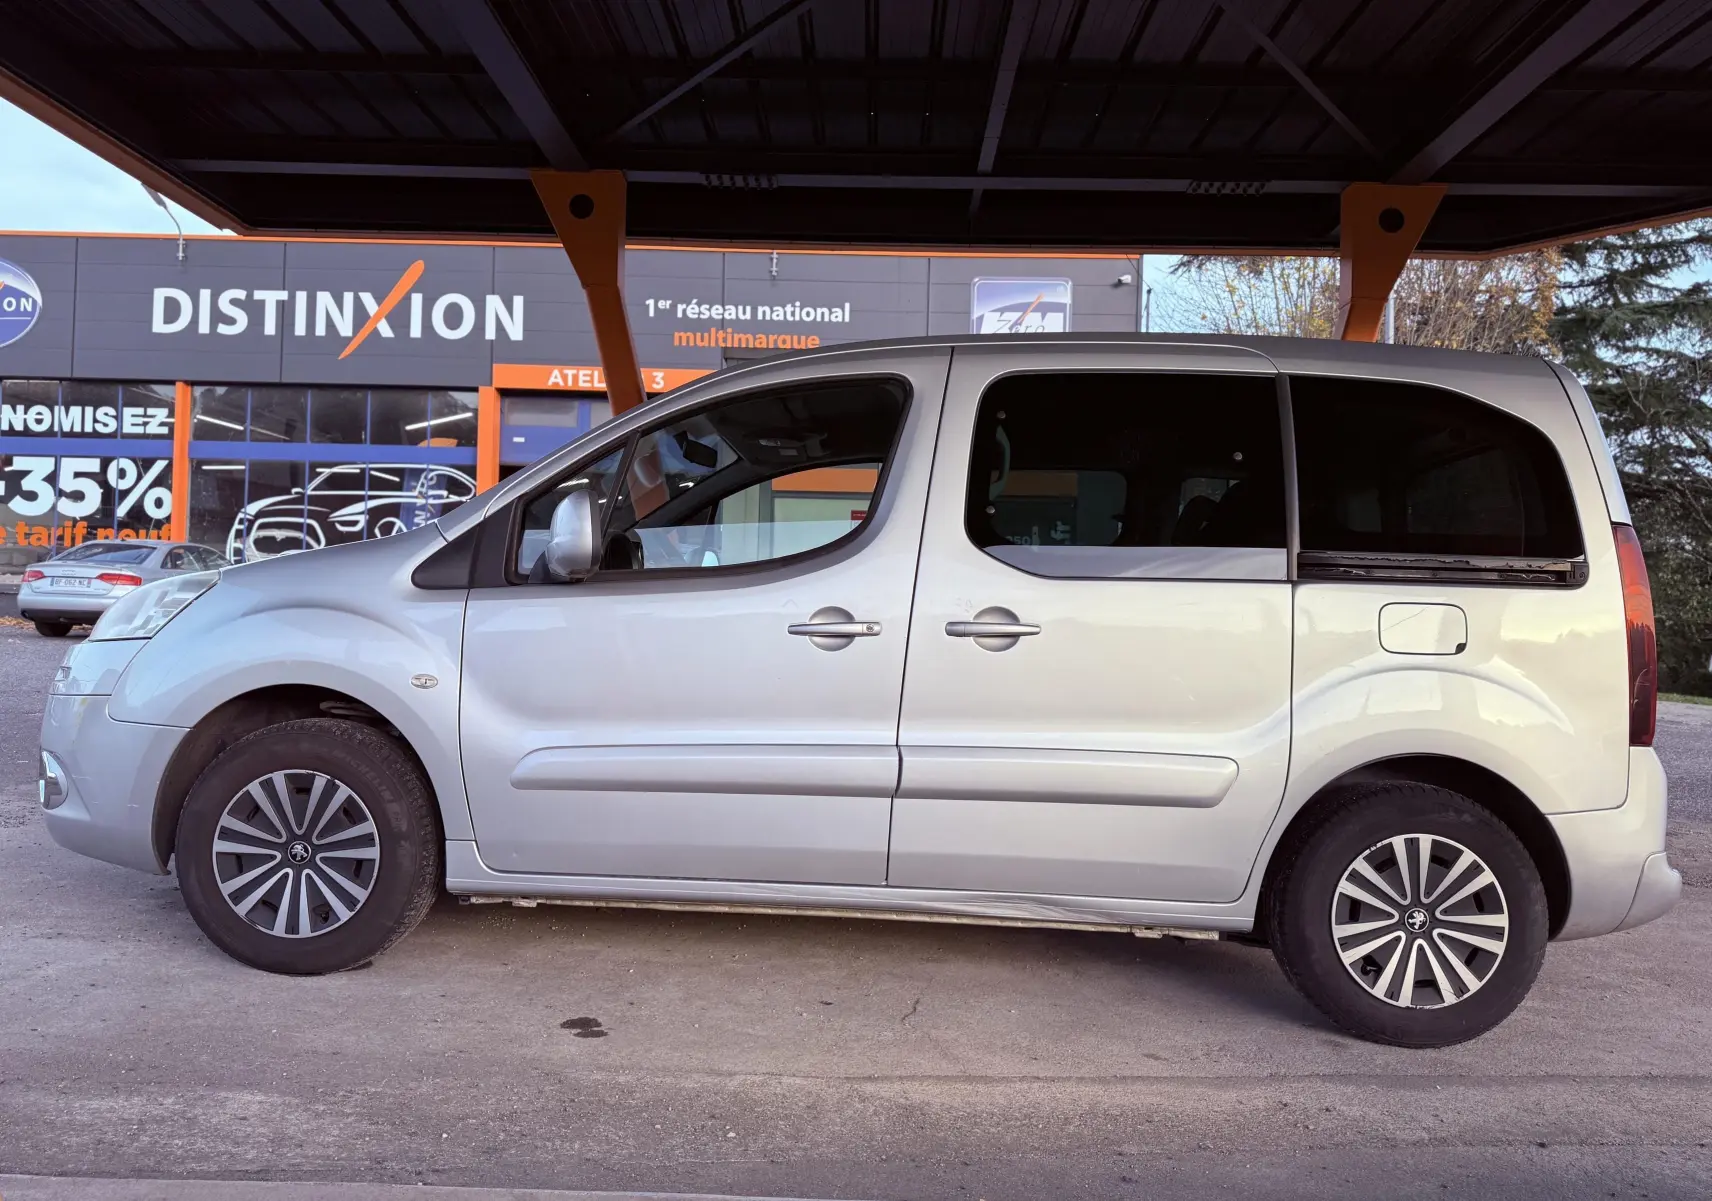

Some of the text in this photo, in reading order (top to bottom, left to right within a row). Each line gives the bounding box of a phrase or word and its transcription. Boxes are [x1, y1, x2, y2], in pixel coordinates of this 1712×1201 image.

[152, 260, 524, 359] DISTINXION
[646, 299, 850, 322] 1er réseau national
[674, 327, 820, 349] multimarque
[548, 368, 665, 388] ATEL 3
[0, 456, 172, 519] 35%
[16, 521, 88, 547] tarif
